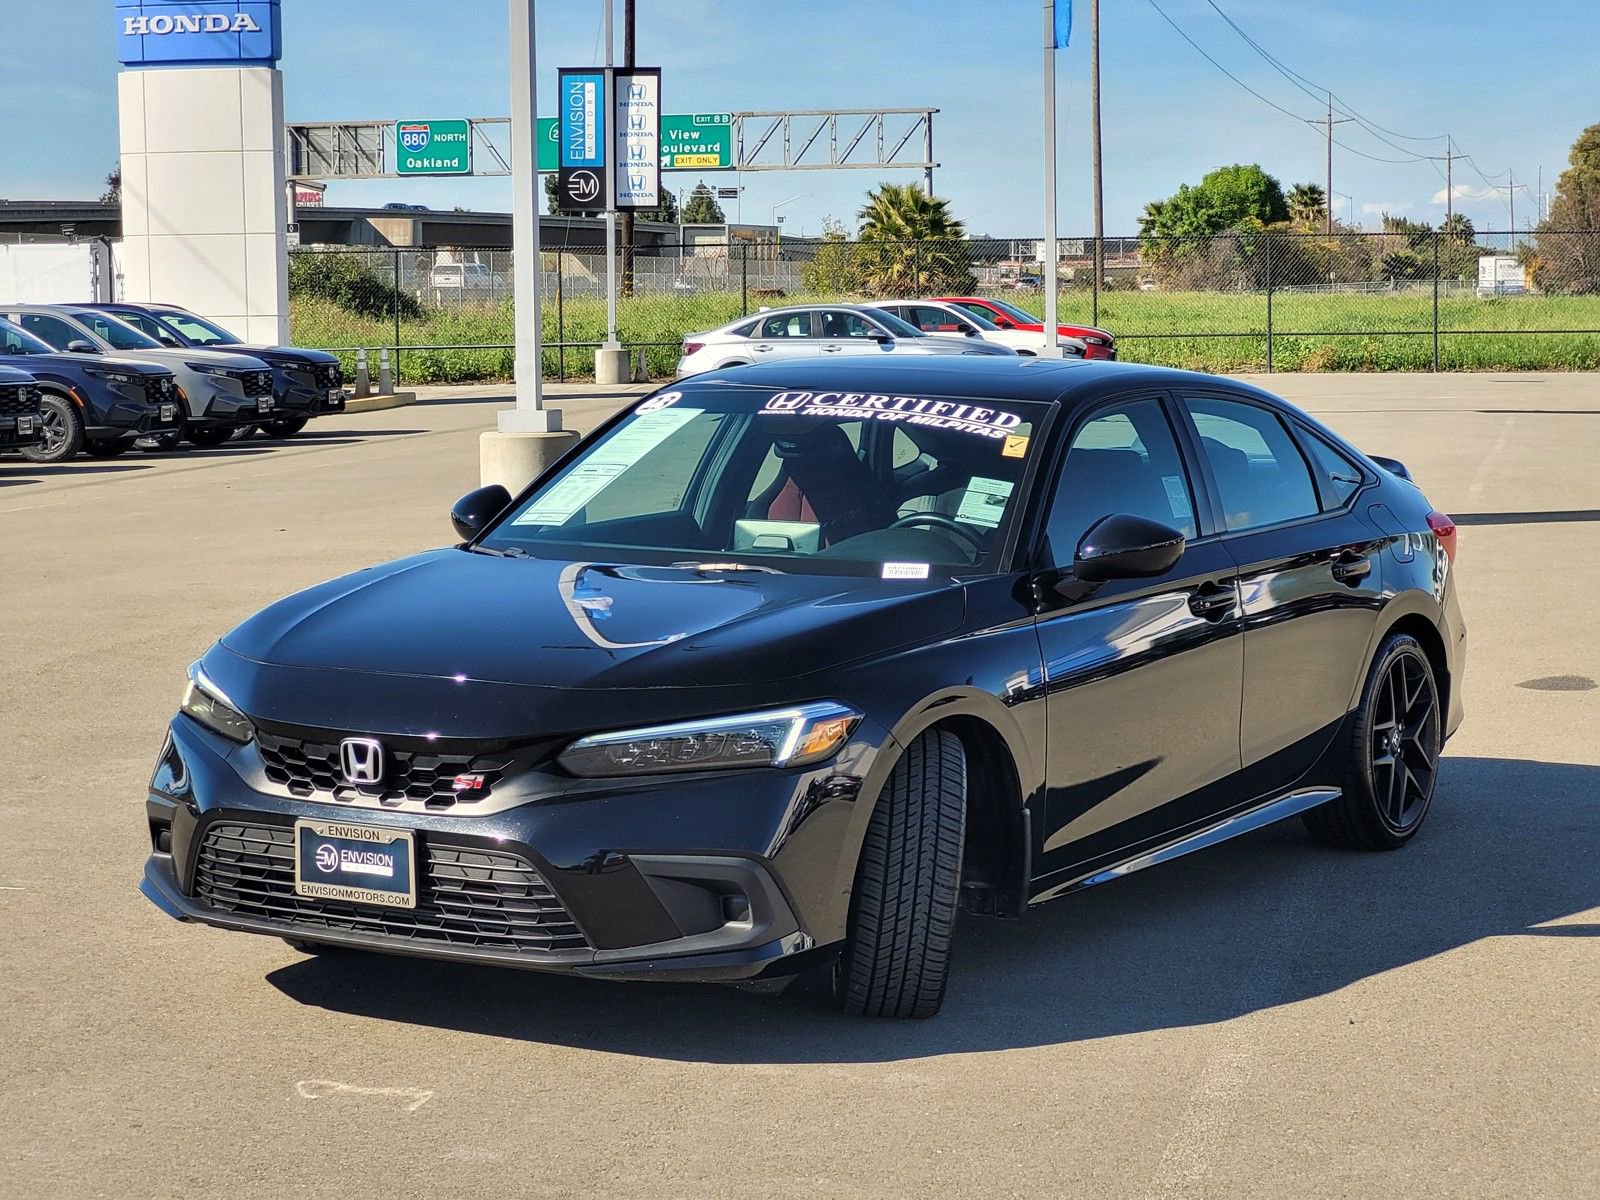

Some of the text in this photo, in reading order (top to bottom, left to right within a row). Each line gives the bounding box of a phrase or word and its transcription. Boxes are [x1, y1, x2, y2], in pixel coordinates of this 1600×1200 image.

[123, 13, 261, 35] HONDA
[569, 82, 584, 160] ENVISION
[586, 88, 594, 154] MOTORS
[403, 133, 466, 146] 880 NORTH
[669, 129, 701, 140] View
[661, 142, 720, 153] oulevard
[406, 157, 459, 168] Oakland
[696, 156, 718, 164] ONLY
[811, 392, 1022, 429] CERTIFIED
[801, 406, 1008, 439] HONDA OF MILPITAS
[328, 825, 380, 840] ENVISION
[341, 849, 393, 867] ENVISION
[301, 884, 410, 906] ENVISIONMOTORS.COM
